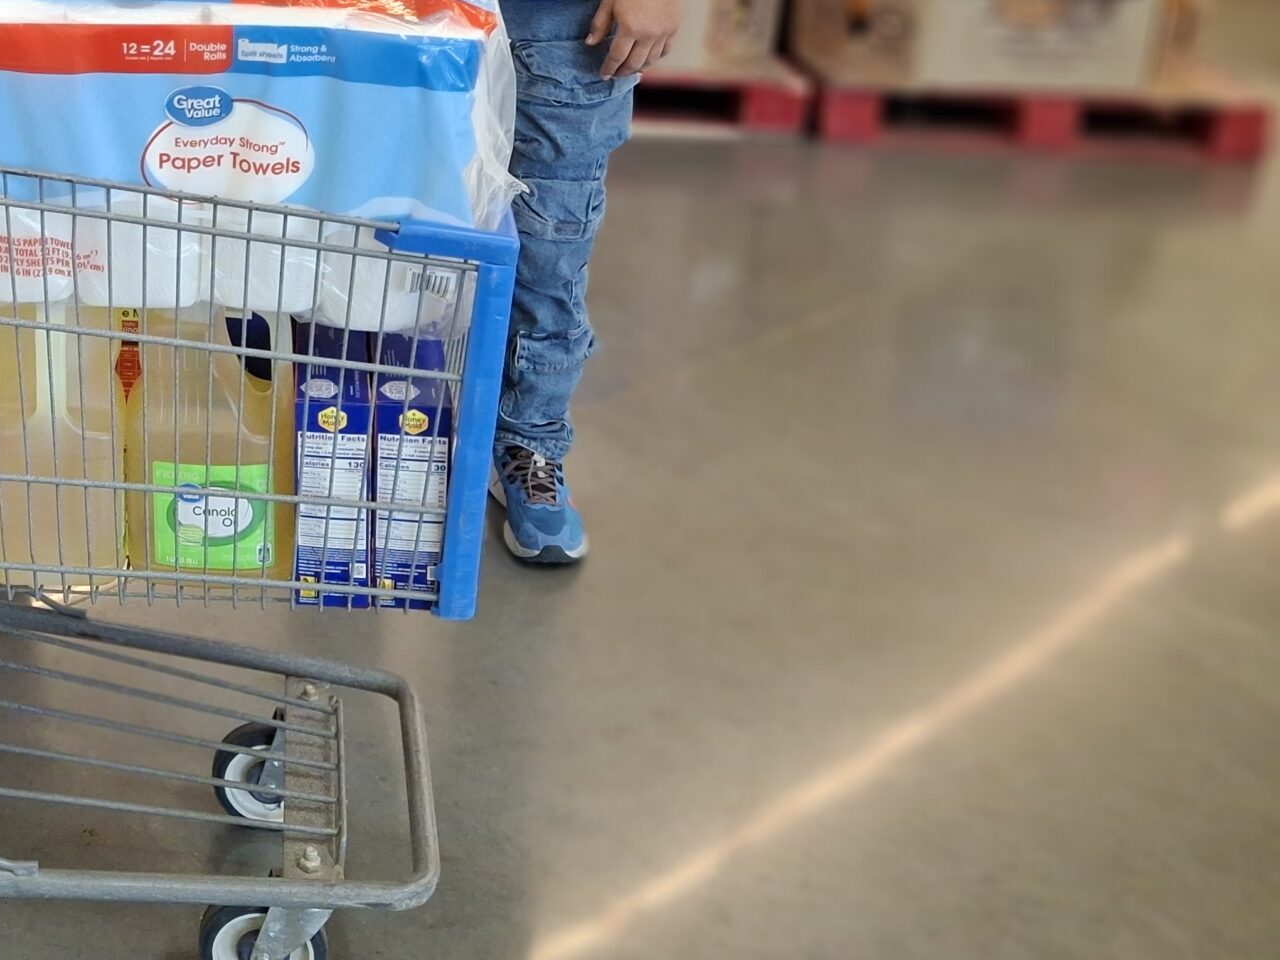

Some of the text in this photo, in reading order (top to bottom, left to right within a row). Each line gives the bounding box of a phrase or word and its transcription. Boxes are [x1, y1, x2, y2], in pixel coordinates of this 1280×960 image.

[189, 42, 227, 52] Double
[289, 44, 318, 55] Strong
[203, 51, 227, 61] Rolls
[289, 54, 336, 64] Absorbent
[173, 94, 221, 110] Great
[185, 108, 221, 119] Value
[174, 135, 236, 149] Everyday
[158, 151, 301, 176] Paper Towels
[300, 432, 366, 443] utritio Facts
[379, 434, 447, 446] Nutrion Fats
